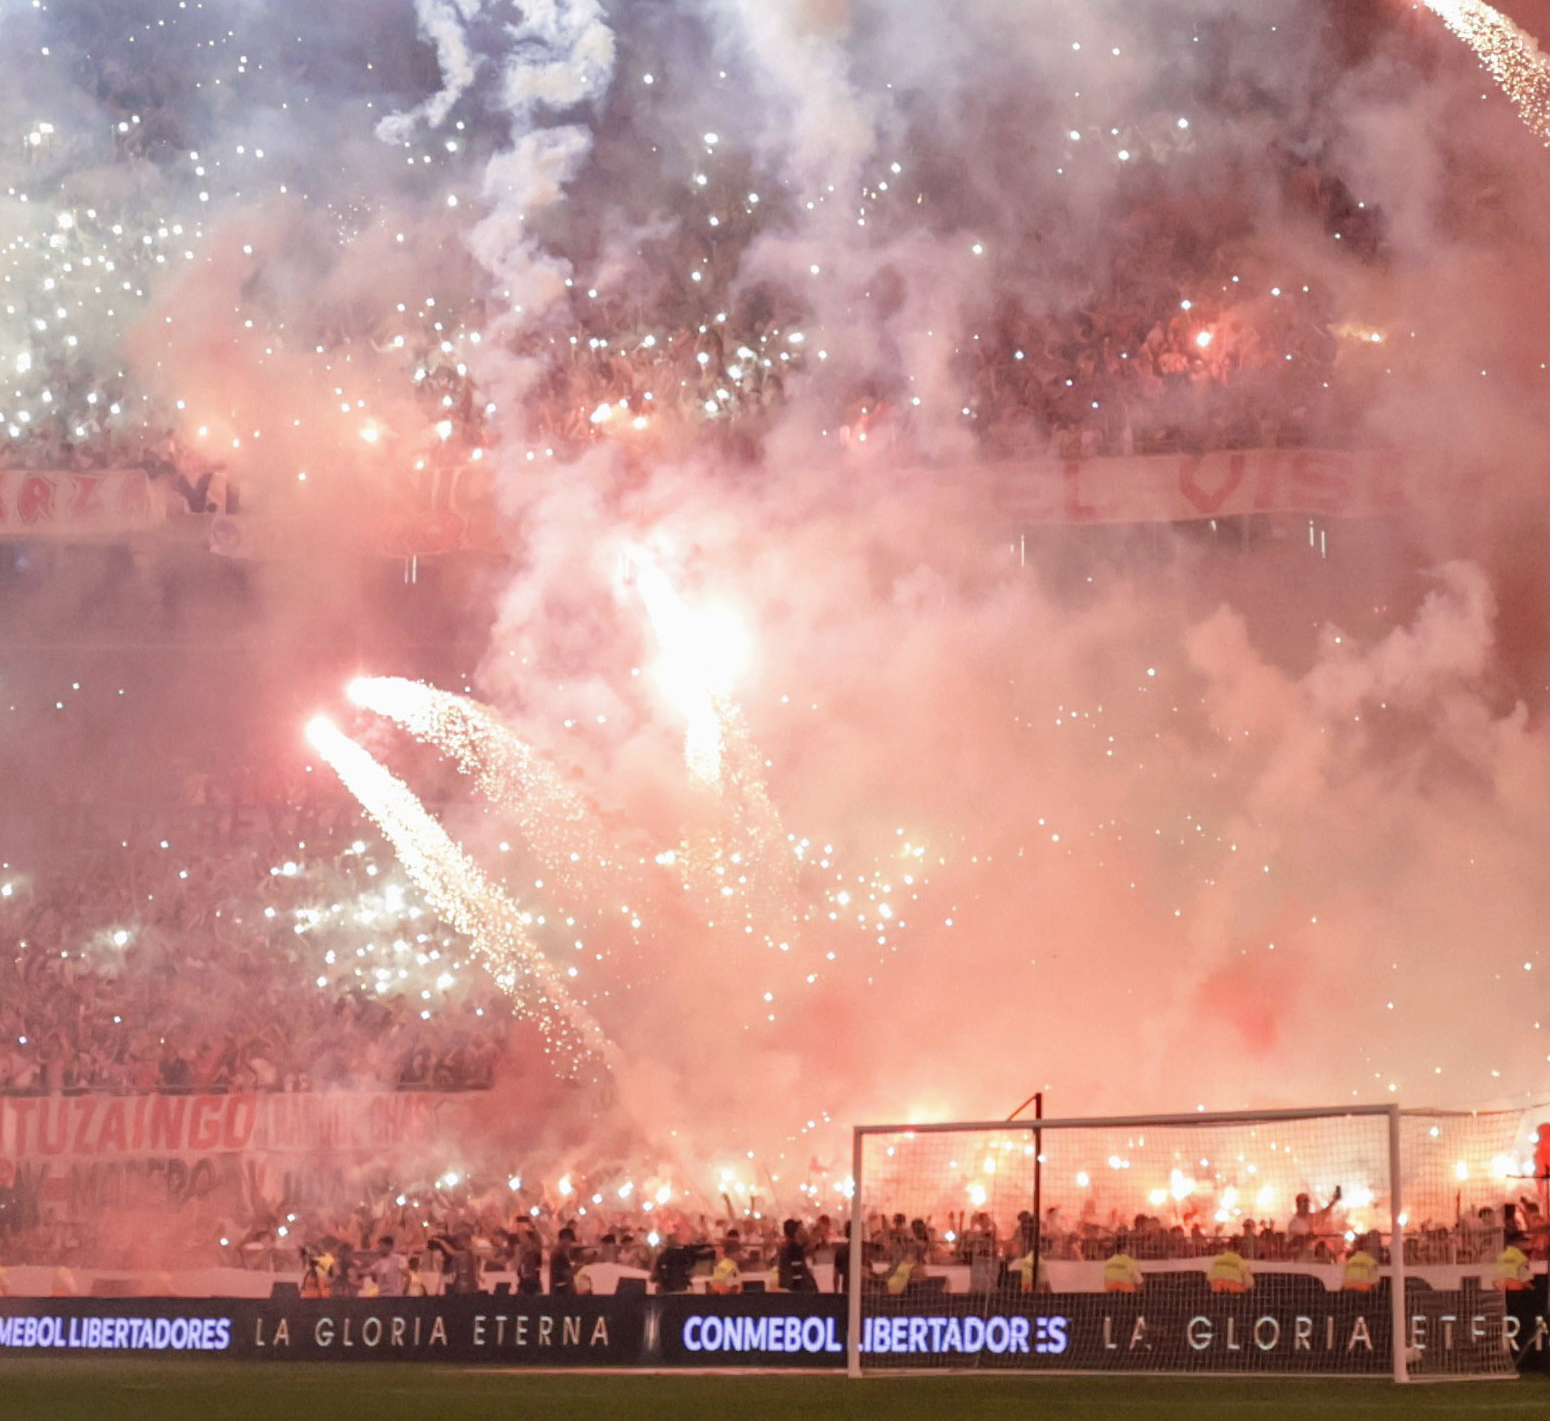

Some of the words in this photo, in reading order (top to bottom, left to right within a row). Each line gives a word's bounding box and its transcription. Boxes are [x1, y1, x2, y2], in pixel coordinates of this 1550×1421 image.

[66, 1315, 231, 1351] LIBERTADORES
[255, 1317, 291, 1347] LA
[315, 1316, 448, 1347] GLORIA
[474, 1315, 610, 1346] ETERNA
[683, 1315, 843, 1352] CONMEBOL
[1104, 1316, 1152, 1350] LA
[1187, 1315, 1372, 1351] GLORIA
